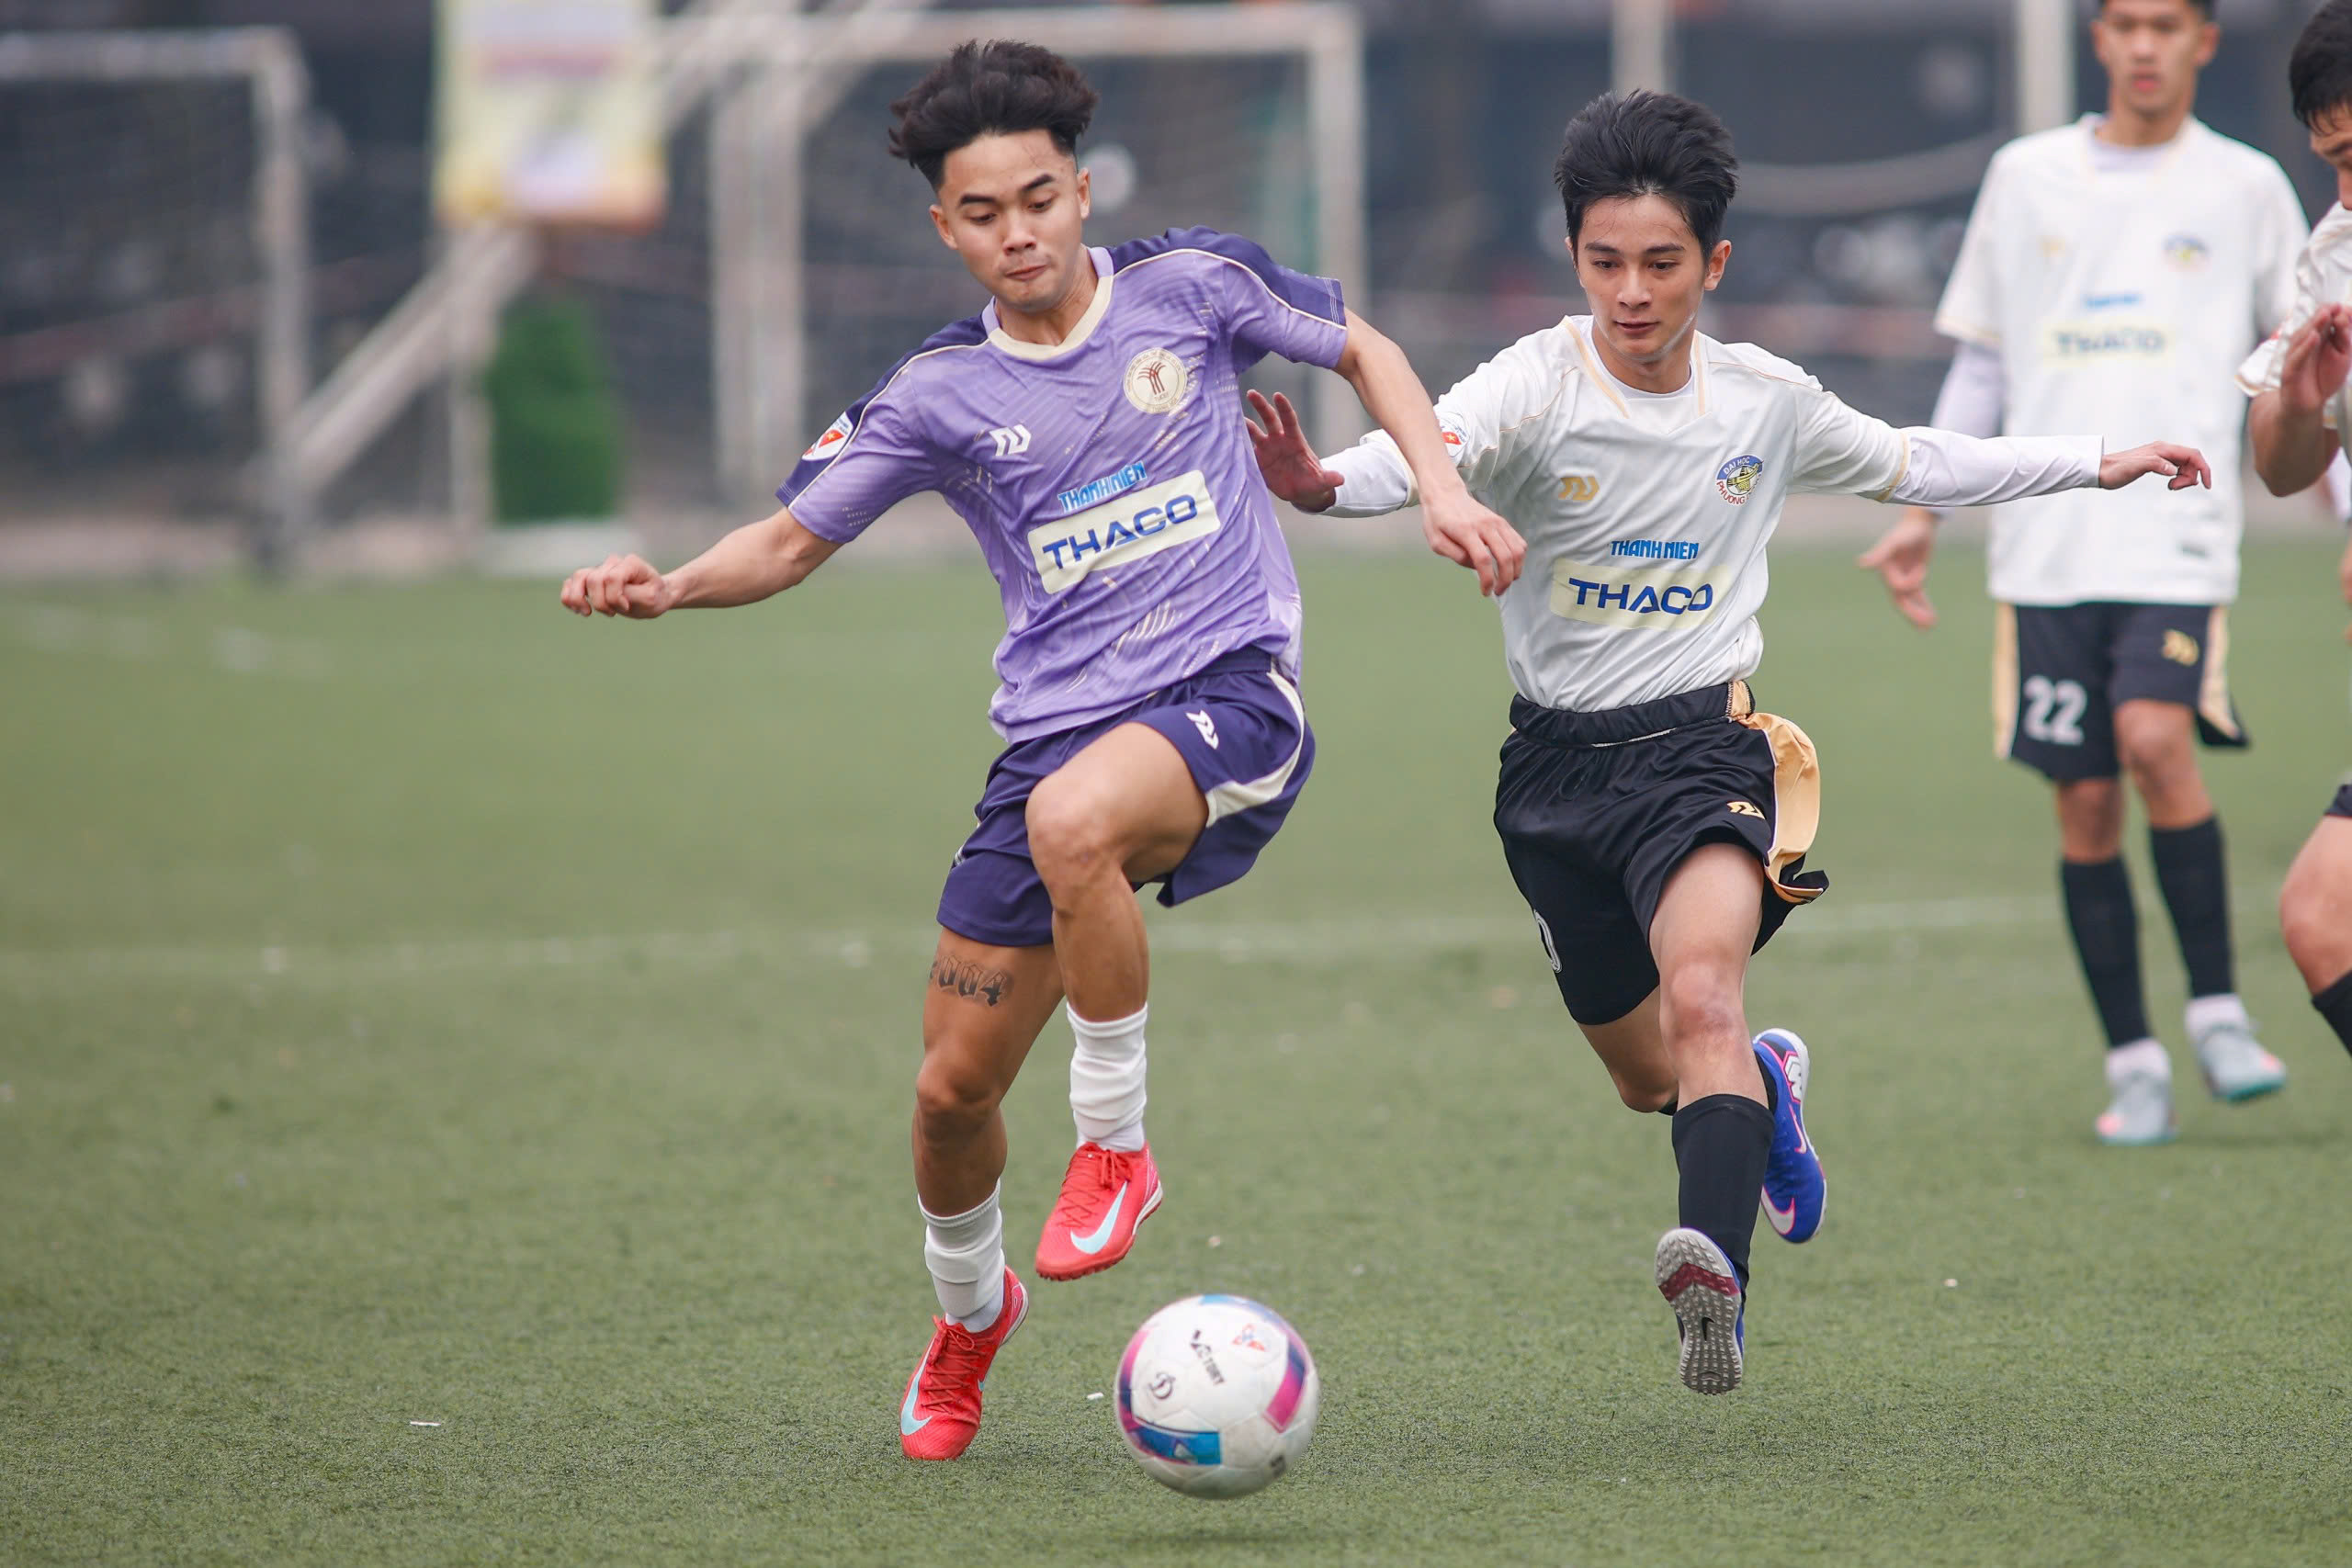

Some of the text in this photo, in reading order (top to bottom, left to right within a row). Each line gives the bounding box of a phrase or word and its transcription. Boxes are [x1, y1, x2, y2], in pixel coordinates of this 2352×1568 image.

[1057, 477, 1111, 513] THANH
[1042, 494, 1198, 570] THACO
[1611, 539, 1662, 558] THANH
[1568, 577, 1713, 615] THACO
[2023, 675, 2087, 746] 22
[929, 954, 1007, 1008] 004
